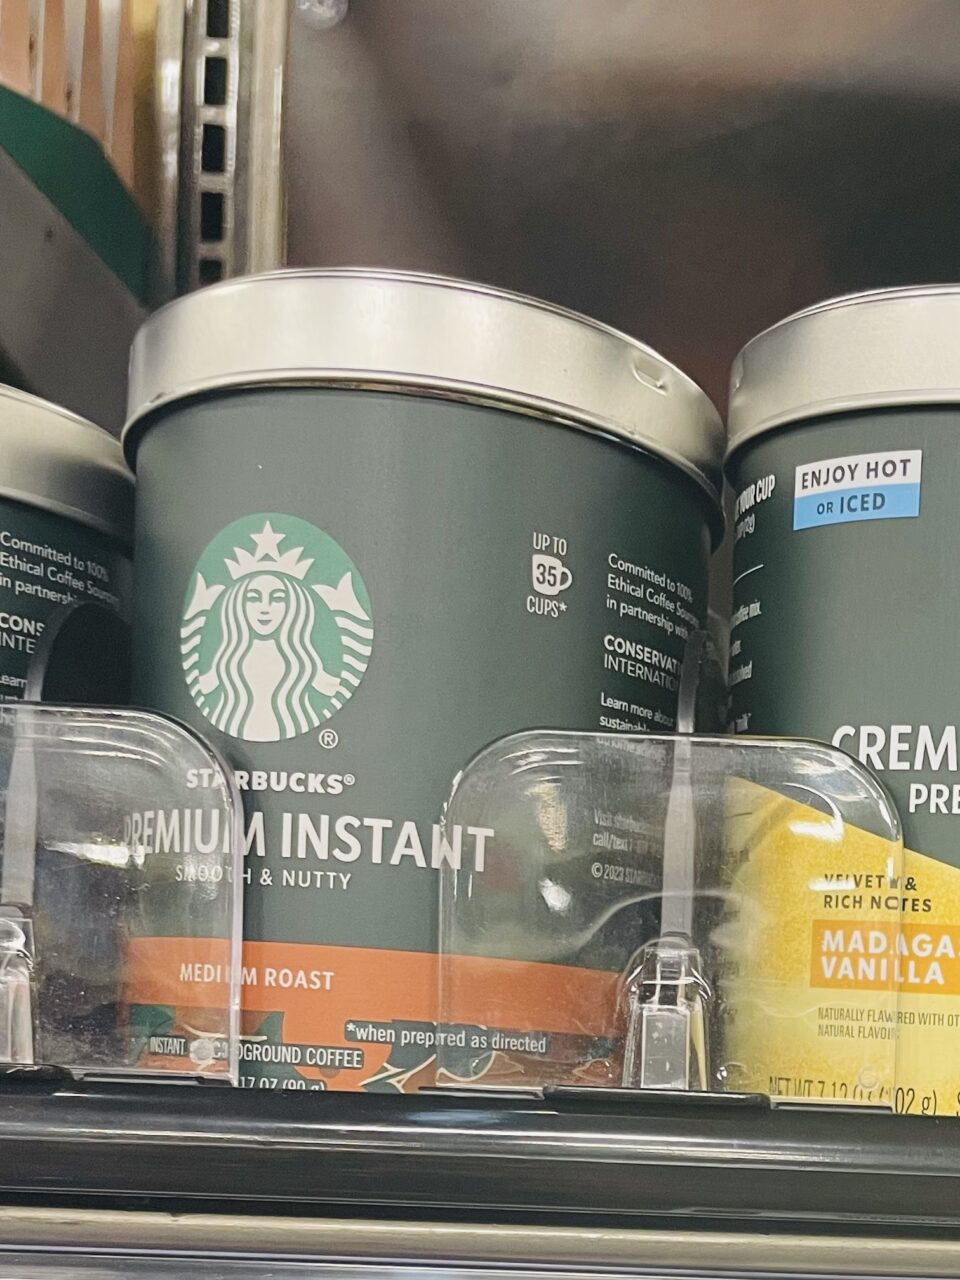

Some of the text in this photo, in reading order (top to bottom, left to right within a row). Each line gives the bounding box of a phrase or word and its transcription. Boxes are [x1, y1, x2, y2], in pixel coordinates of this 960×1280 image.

[801, 459, 912, 490] ENJOY HOT
[817, 492, 886, 515] OR ICED
[532, 532, 567, 556] UP TO
[536, 563, 557, 587] 35
[608, 553, 666, 588] Committed
[607, 573, 644, 600] Ethical
[619, 601, 674, 636] partnership
[600, 692, 629, 712] Learn
[281, 812, 495, 873] INSTANT
[260, 868, 273, 886] &
[282, 869, 352, 890] NUTTY
[823, 895, 932, 913] RICH NOTES
[264, 968, 335, 990] ROAST
[821, 957, 945, 985] VANILLA
[818, 1007, 864, 1022] NATURALLY
[918, 1013, 945, 1025] WITH
[471, 1034, 547, 1052] as directed
[306, 1046, 362, 1068] COFFEE
